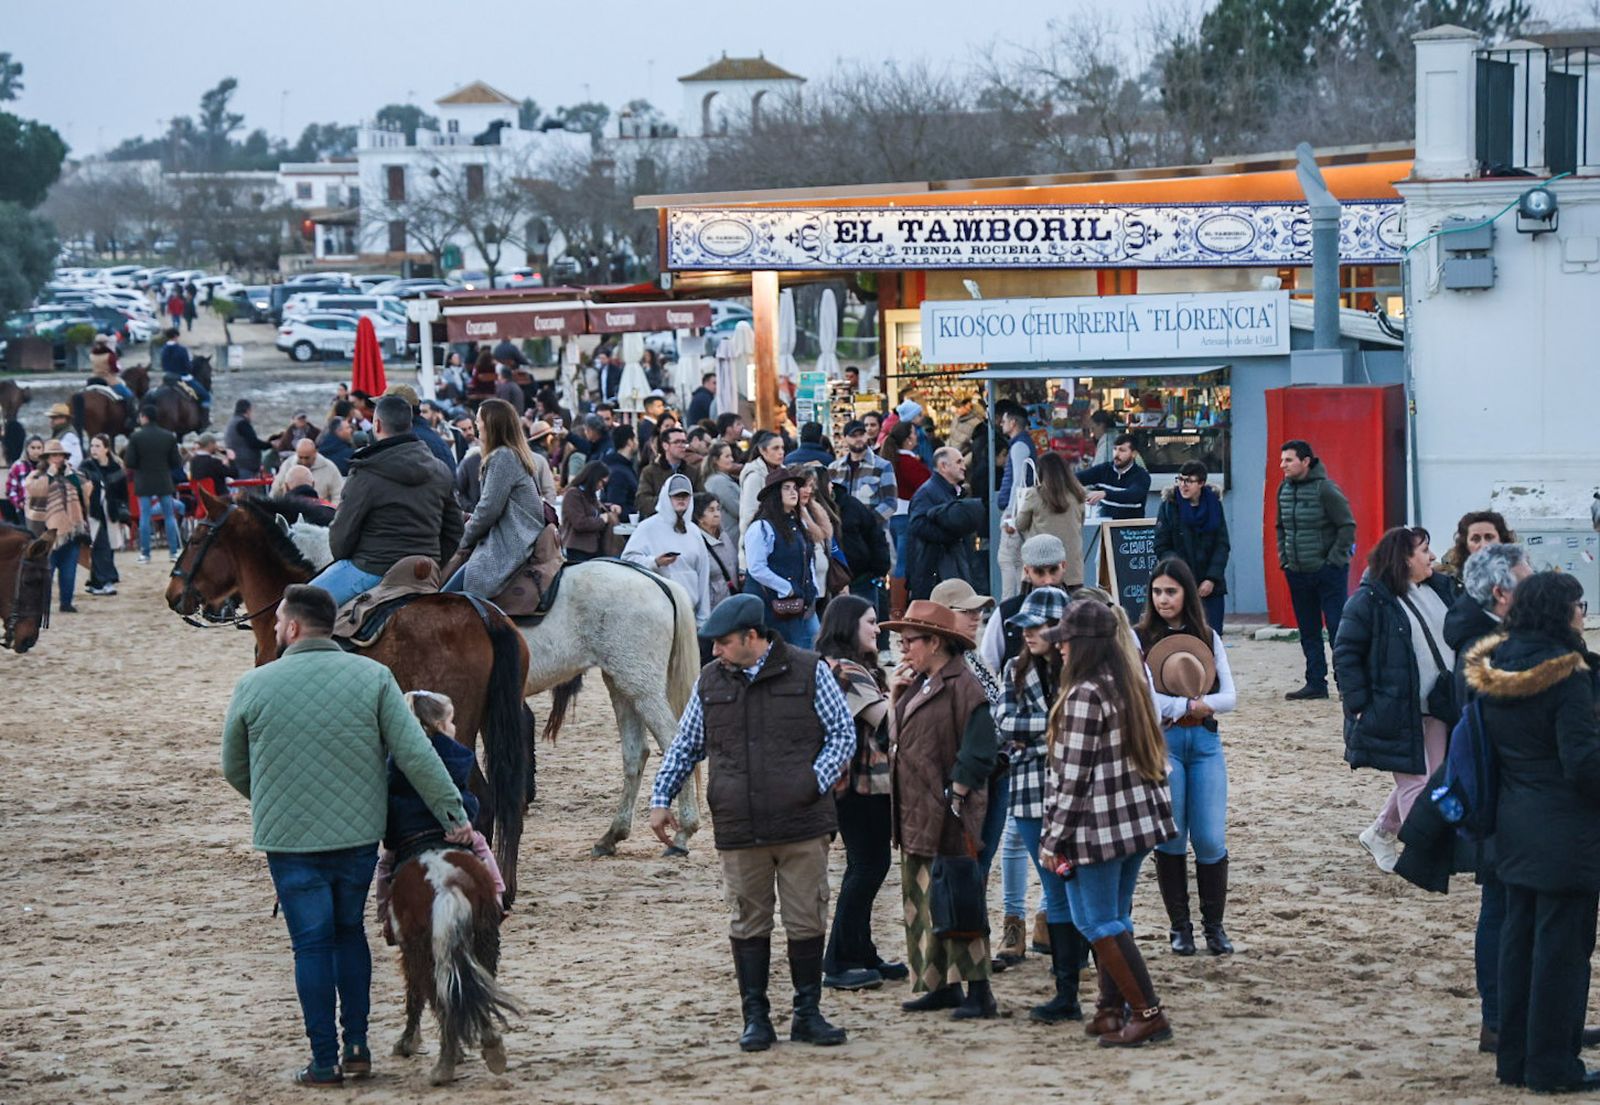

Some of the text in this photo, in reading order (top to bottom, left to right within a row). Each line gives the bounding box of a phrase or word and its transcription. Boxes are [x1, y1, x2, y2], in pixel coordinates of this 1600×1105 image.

[833, 217, 1112, 244] EL TAMBORIL
[901, 244, 1042, 256] TIENDA ROCIERA
[939, 303, 1274, 338] KIOSCO CHURRERIA "FLORENCIA"
[1119, 540, 1155, 555] CHUR
[1129, 555, 1159, 570] CAF
